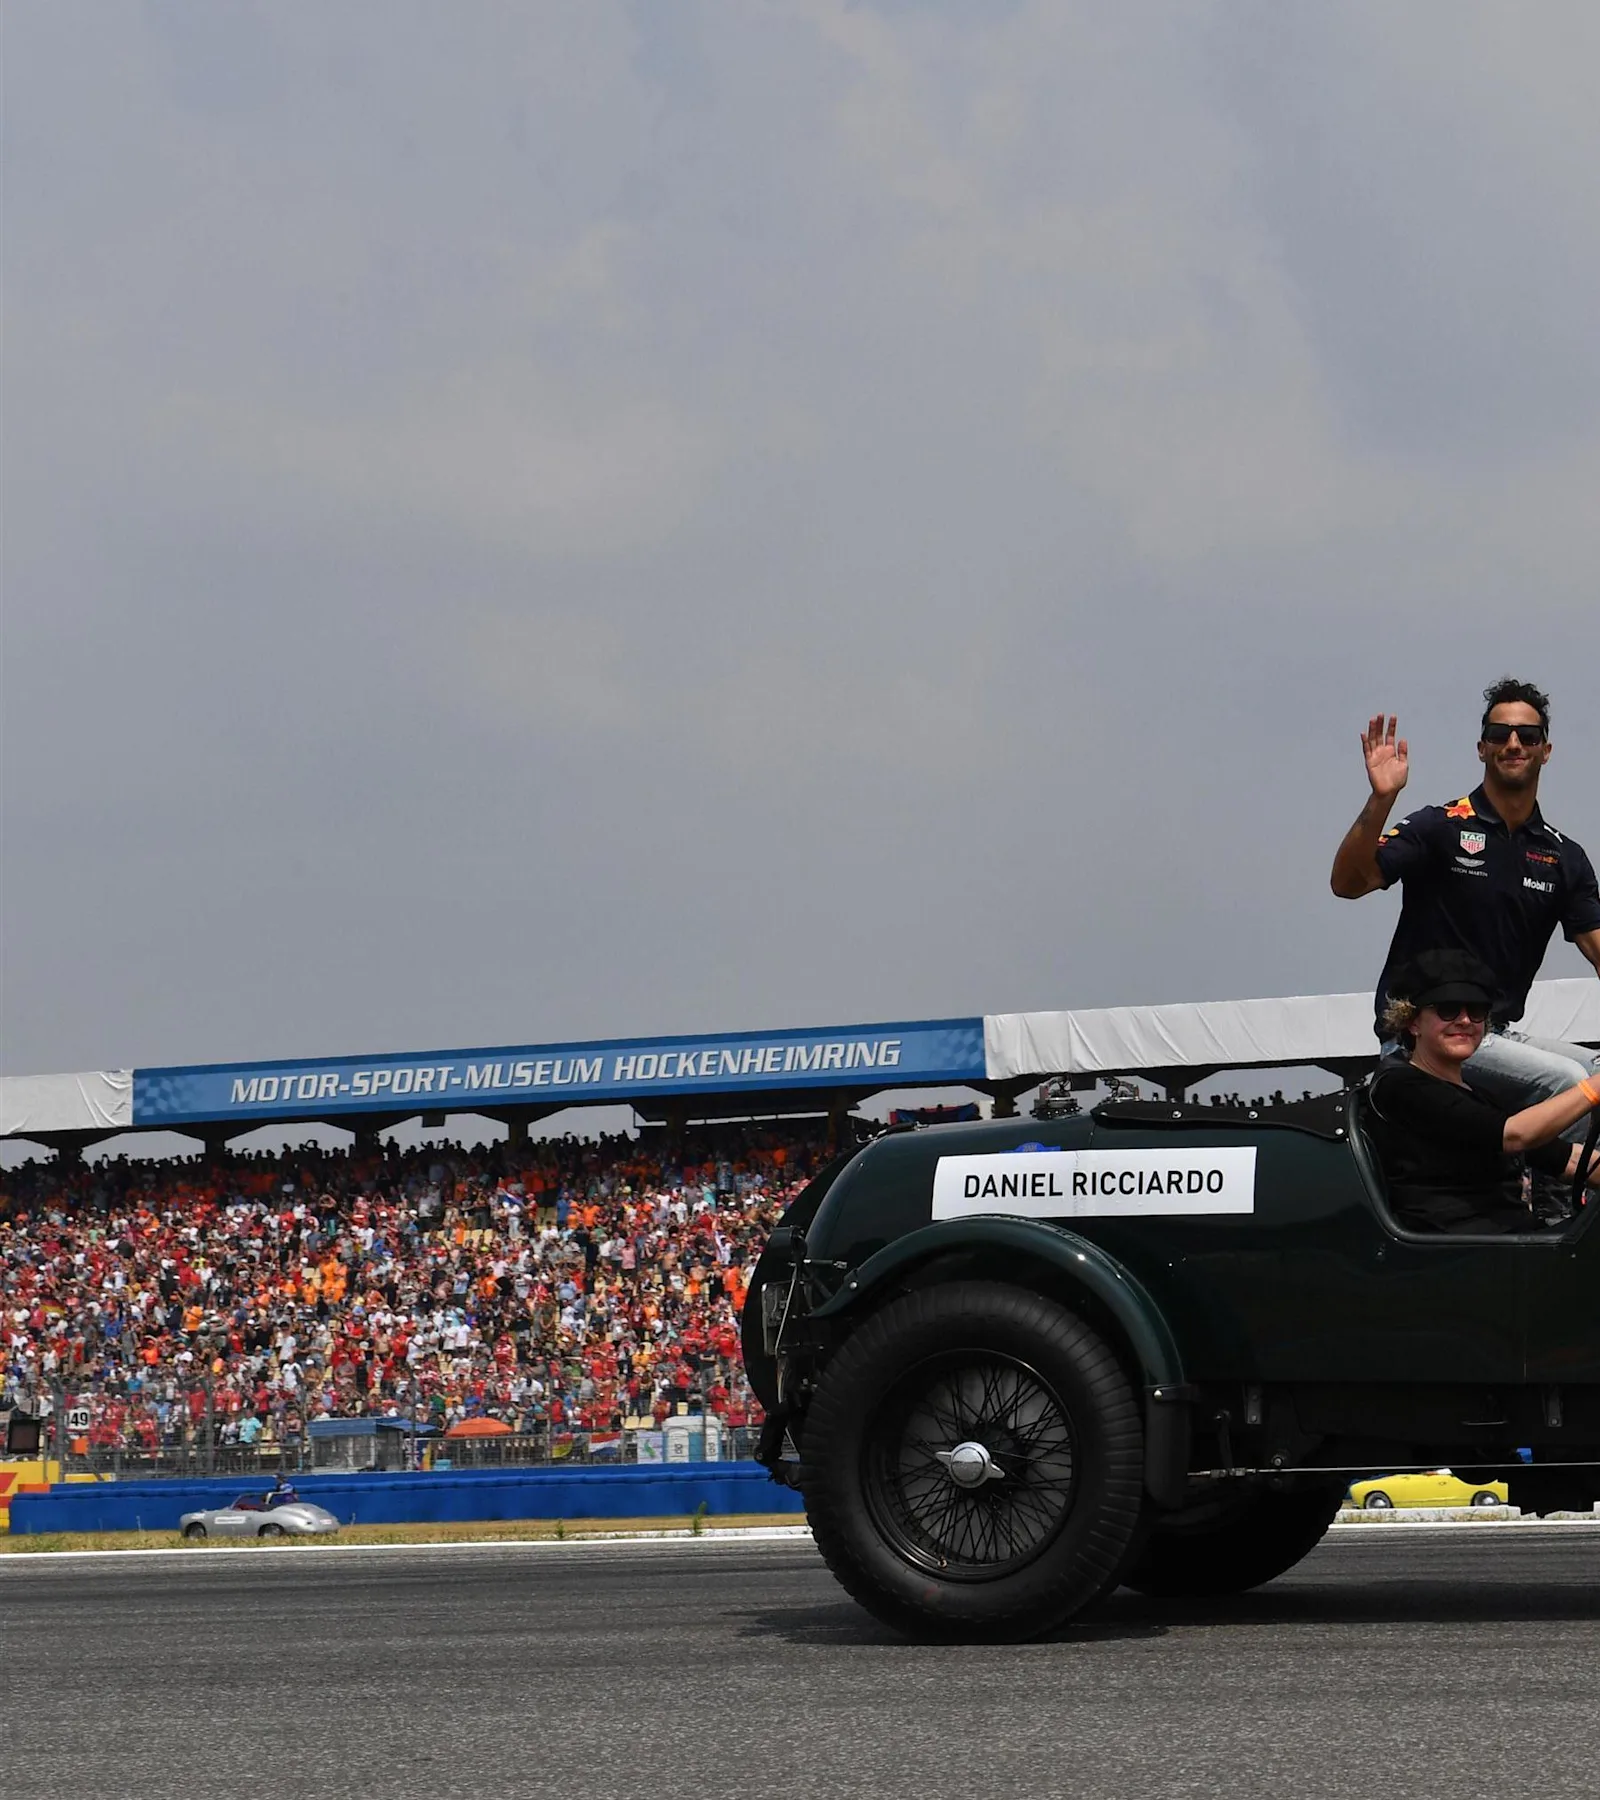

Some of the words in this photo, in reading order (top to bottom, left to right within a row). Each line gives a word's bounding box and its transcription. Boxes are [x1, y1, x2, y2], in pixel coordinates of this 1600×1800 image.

[1462, 832, 1483, 841] TAG
[1468, 869, 1488, 877] MARTIN
[1523, 877, 1546, 891] Mobil
[230, 1058, 603, 1103] MOTOR-SPORT-MUSEUM
[613, 1040, 902, 1081] HOCKENHEIMRING
[964, 1173, 1062, 1198] DANIEL
[1072, 1170, 1224, 1196] RICCIARDO
